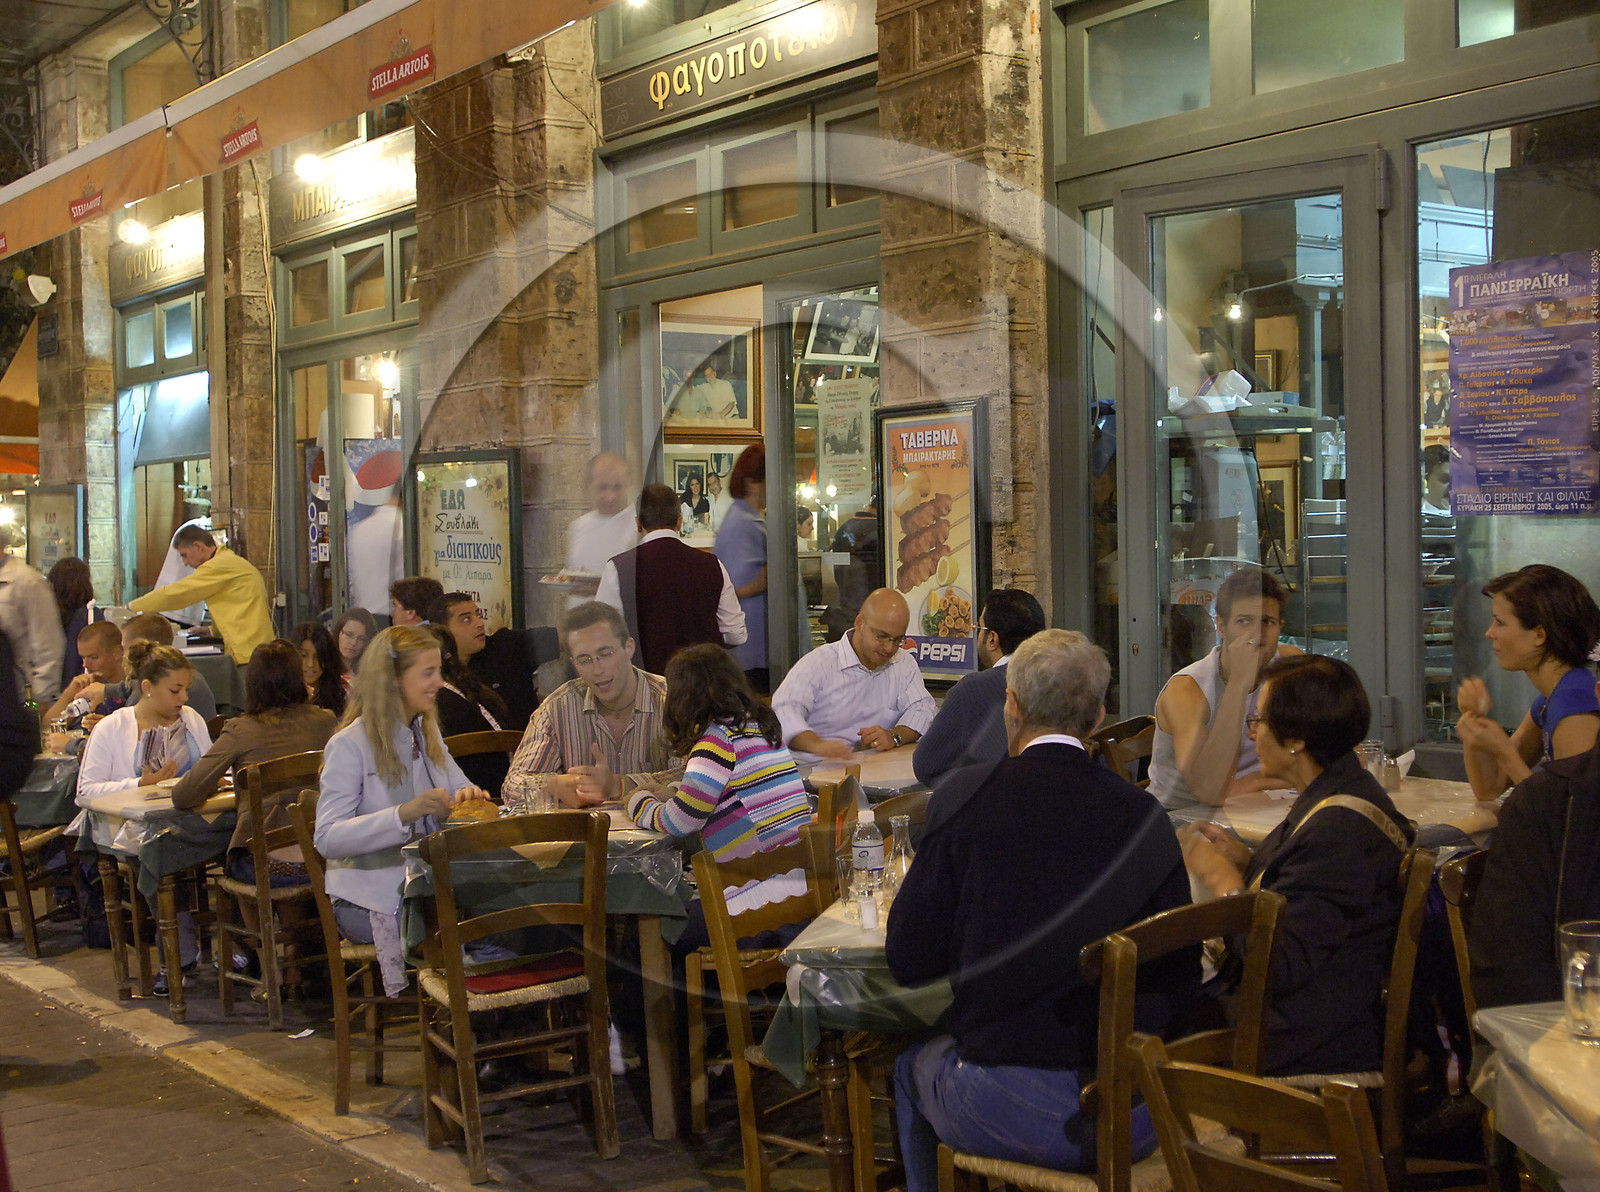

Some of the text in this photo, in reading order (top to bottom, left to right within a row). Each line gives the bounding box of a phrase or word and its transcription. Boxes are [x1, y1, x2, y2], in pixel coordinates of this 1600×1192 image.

[371, 53, 430, 92] STELLA ARTOIS
[1591, 250, 1600, 273] 2005
[1470, 271, 1507, 283] ΜΕΓΑΛΗ
[1470, 272, 1569, 298] ΠΑΝΣΕΡΡΑΪΚΗ
[1553, 284, 1587, 296] ΓΙΟΡΤΗ
[1501, 396, 1511, 406] Δ.
[1512, 392, 1577, 406] Σαββόπουλος
[900, 428, 959, 450] ΤΑΒΕΡΝΑ
[1527, 438, 1535, 446] Π.
[1536, 437, 1561, 445] Τόνιος
[903, 449, 957, 464] ΜΠΑΙΡΑΚΤΑΡΗΣ
[440, 489, 466, 510] ΕΔΩ
[1456, 490, 1593, 504] ΣΤΑΔΙΟ ΕΙΡΗΝΗΣ ΚΑΙ ΦΙΛΙΑΣ
[1456, 503, 1483, 511] ΚΥΡΙΑΚΗ
[1484, 503, 1492, 511] 25
[1493, 502, 1536, 511] ΣΕΠΤΕΜΒΡΙΟΥ
[1555, 502, 1569, 511] ώρα
[434, 512, 479, 533] Σουβλάκι
[433, 535, 502, 567] για διαιτικούς
[464, 565, 493, 586] λιπαρά
[919, 642, 967, 663] PEPSI
